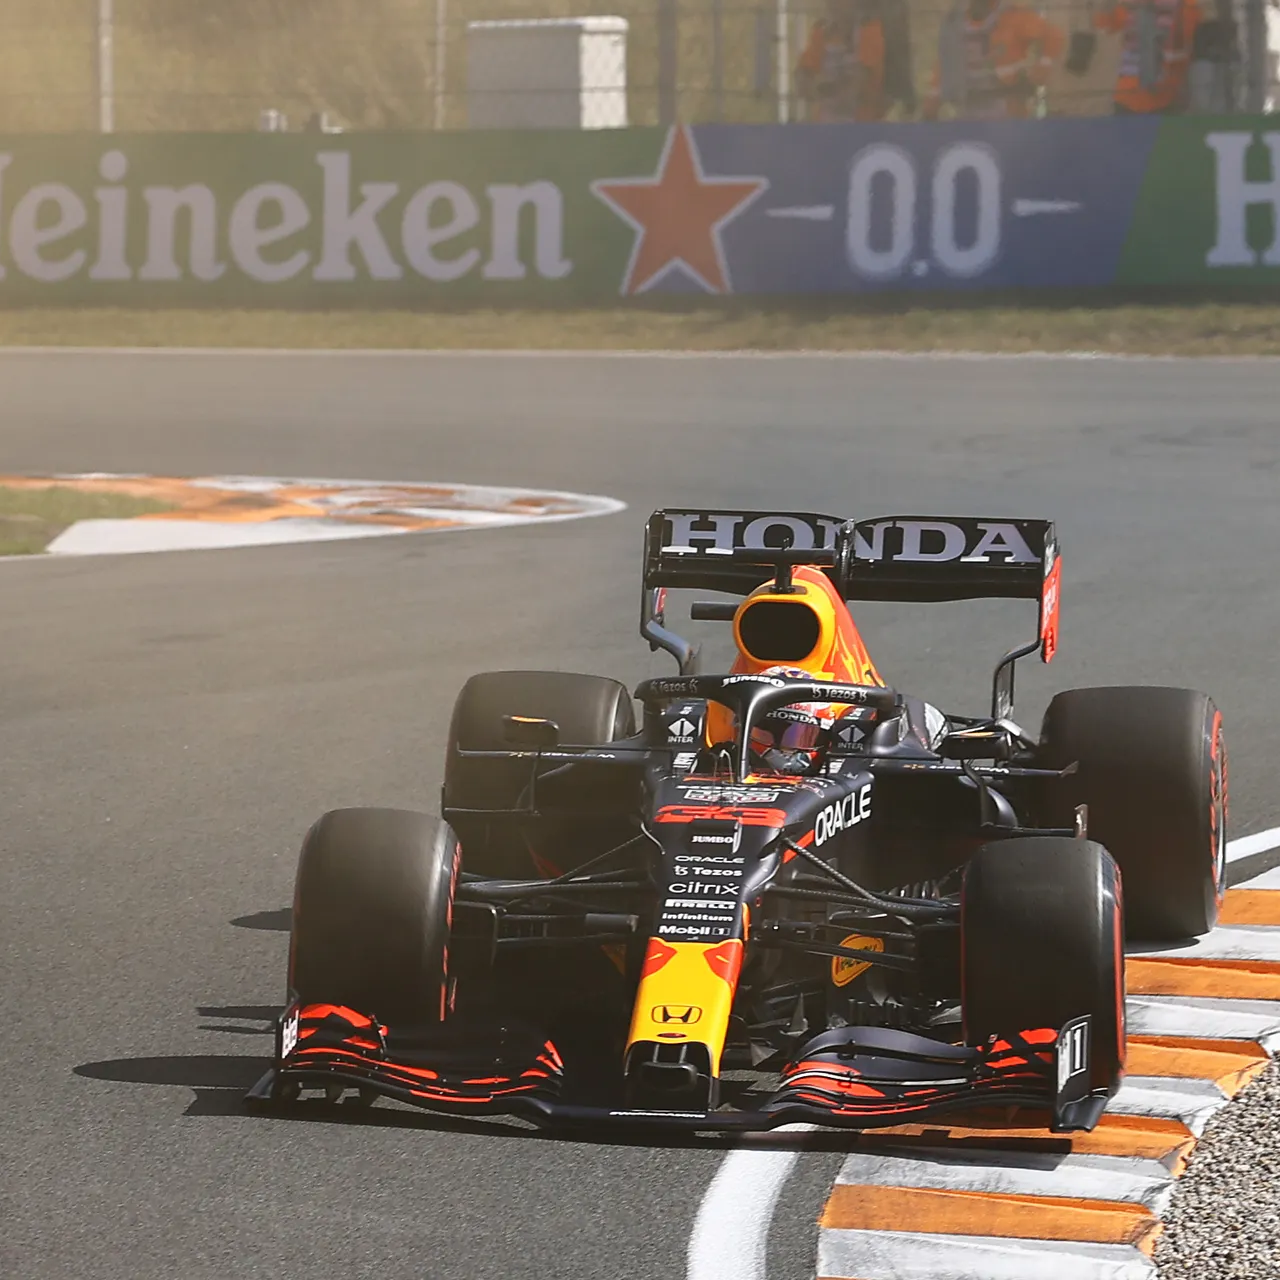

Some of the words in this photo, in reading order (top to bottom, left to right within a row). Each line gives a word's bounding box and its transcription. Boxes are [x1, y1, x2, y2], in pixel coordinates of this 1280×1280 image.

[845, 141, 1001, 277] 0.0
[661, 513, 1042, 563] HONDA
[659, 681, 686, 693] Tezos
[721, 676, 785, 687] JUMBO
[825, 688, 857, 700] Tezos
[837, 742, 864, 751] INTER
[815, 783, 871, 847] ORACLE
[692, 867, 742, 876] Tezos
[662, 913, 733, 921] infinitum
[659, 926, 710, 934] Mobil
